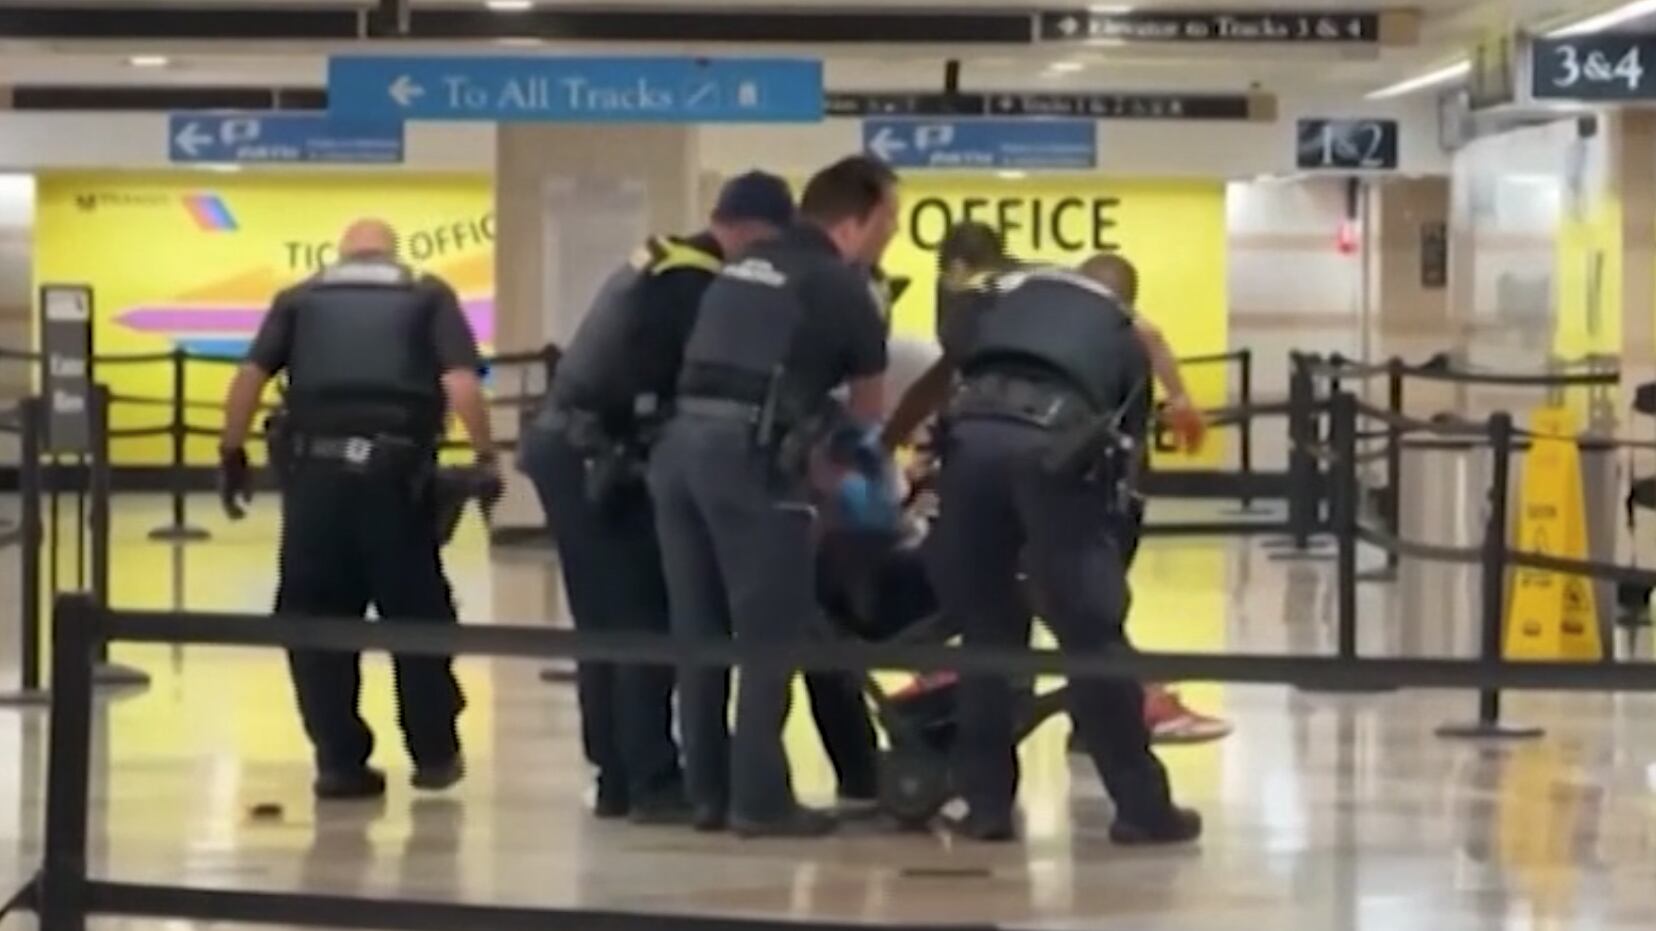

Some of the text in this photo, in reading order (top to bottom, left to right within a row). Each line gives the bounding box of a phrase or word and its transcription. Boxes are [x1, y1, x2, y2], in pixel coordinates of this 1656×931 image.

[1552, 44, 1644, 91] 3&4
[442, 76, 673, 109] To All Tracks
